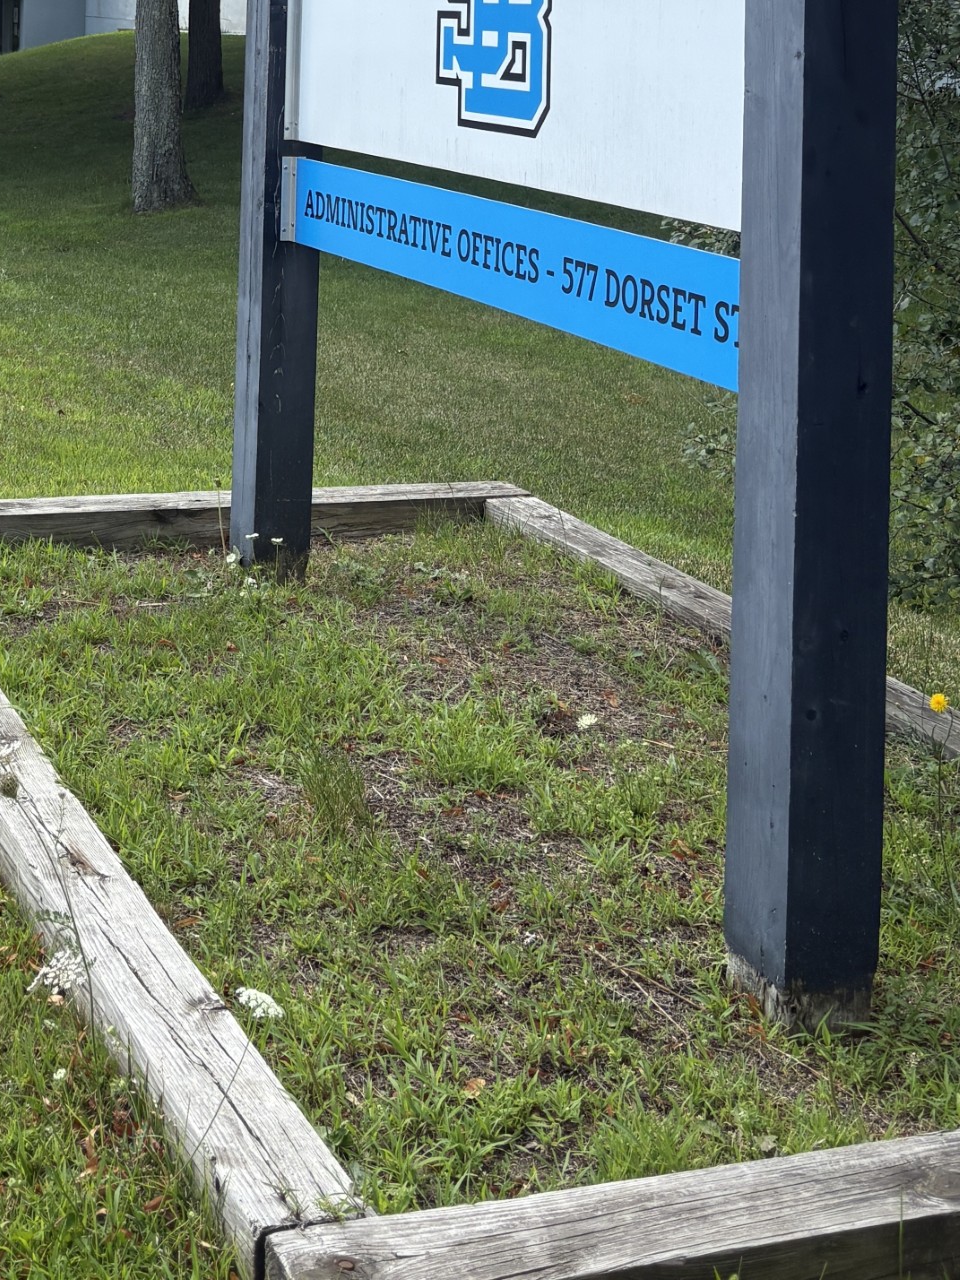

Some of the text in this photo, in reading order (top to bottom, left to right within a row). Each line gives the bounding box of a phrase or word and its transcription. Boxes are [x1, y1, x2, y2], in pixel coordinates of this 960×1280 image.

[304, 189, 452, 258] ADMINISTRATIVE
[457, 229, 540, 284] OFFICES
[561, 256, 599, 303] 577
[605, 269, 706, 336] DORSET
